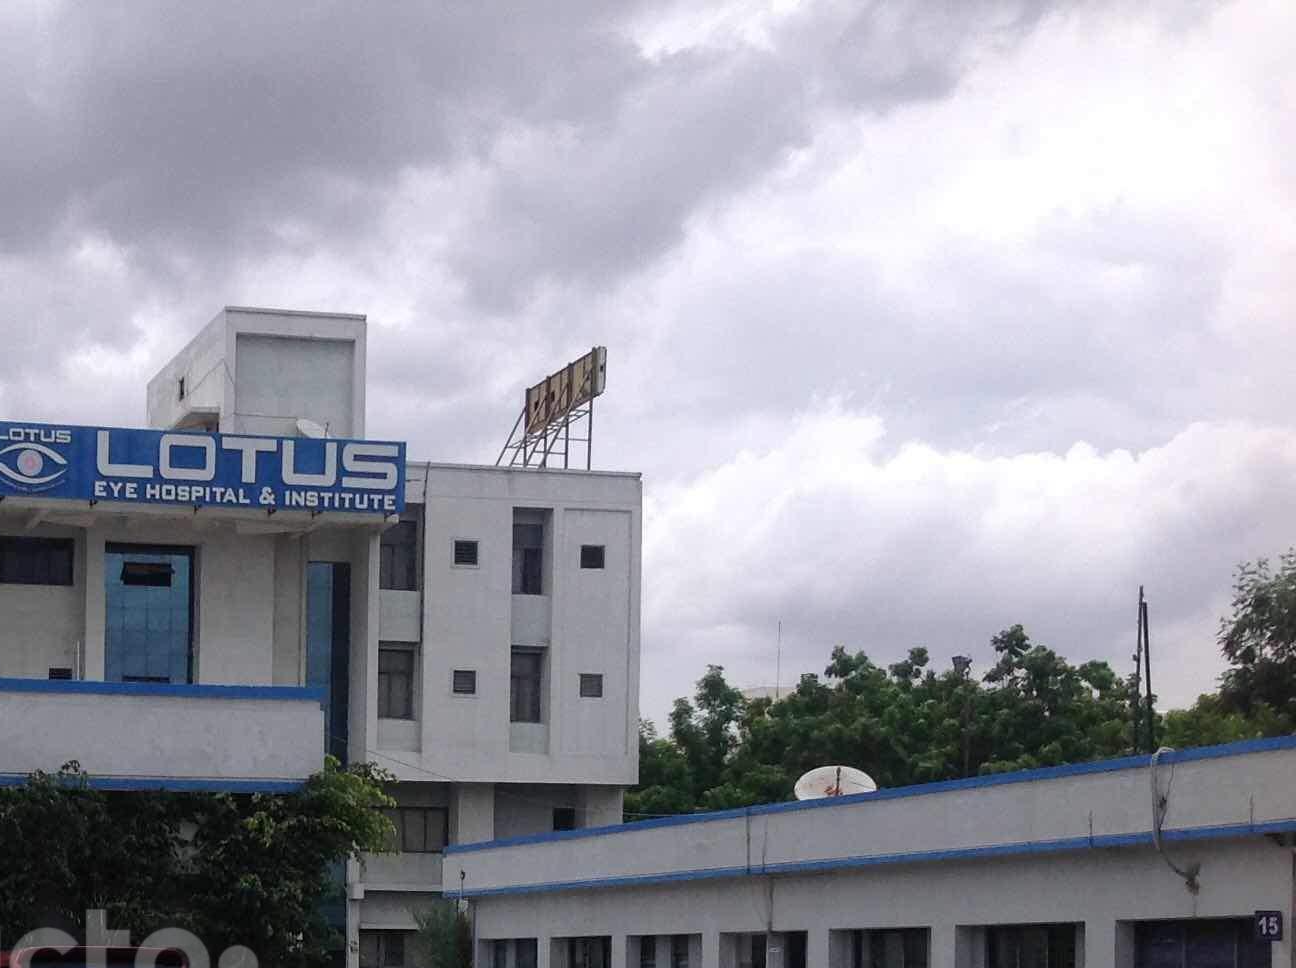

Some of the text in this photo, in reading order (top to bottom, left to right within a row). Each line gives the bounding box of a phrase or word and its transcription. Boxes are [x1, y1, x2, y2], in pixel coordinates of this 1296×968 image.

[96, 430, 400, 489] LOTUS
[94, 480, 397, 511] EYE HOSPITAL & INSTITUTE
[1258, 916, 1279, 935] 15
